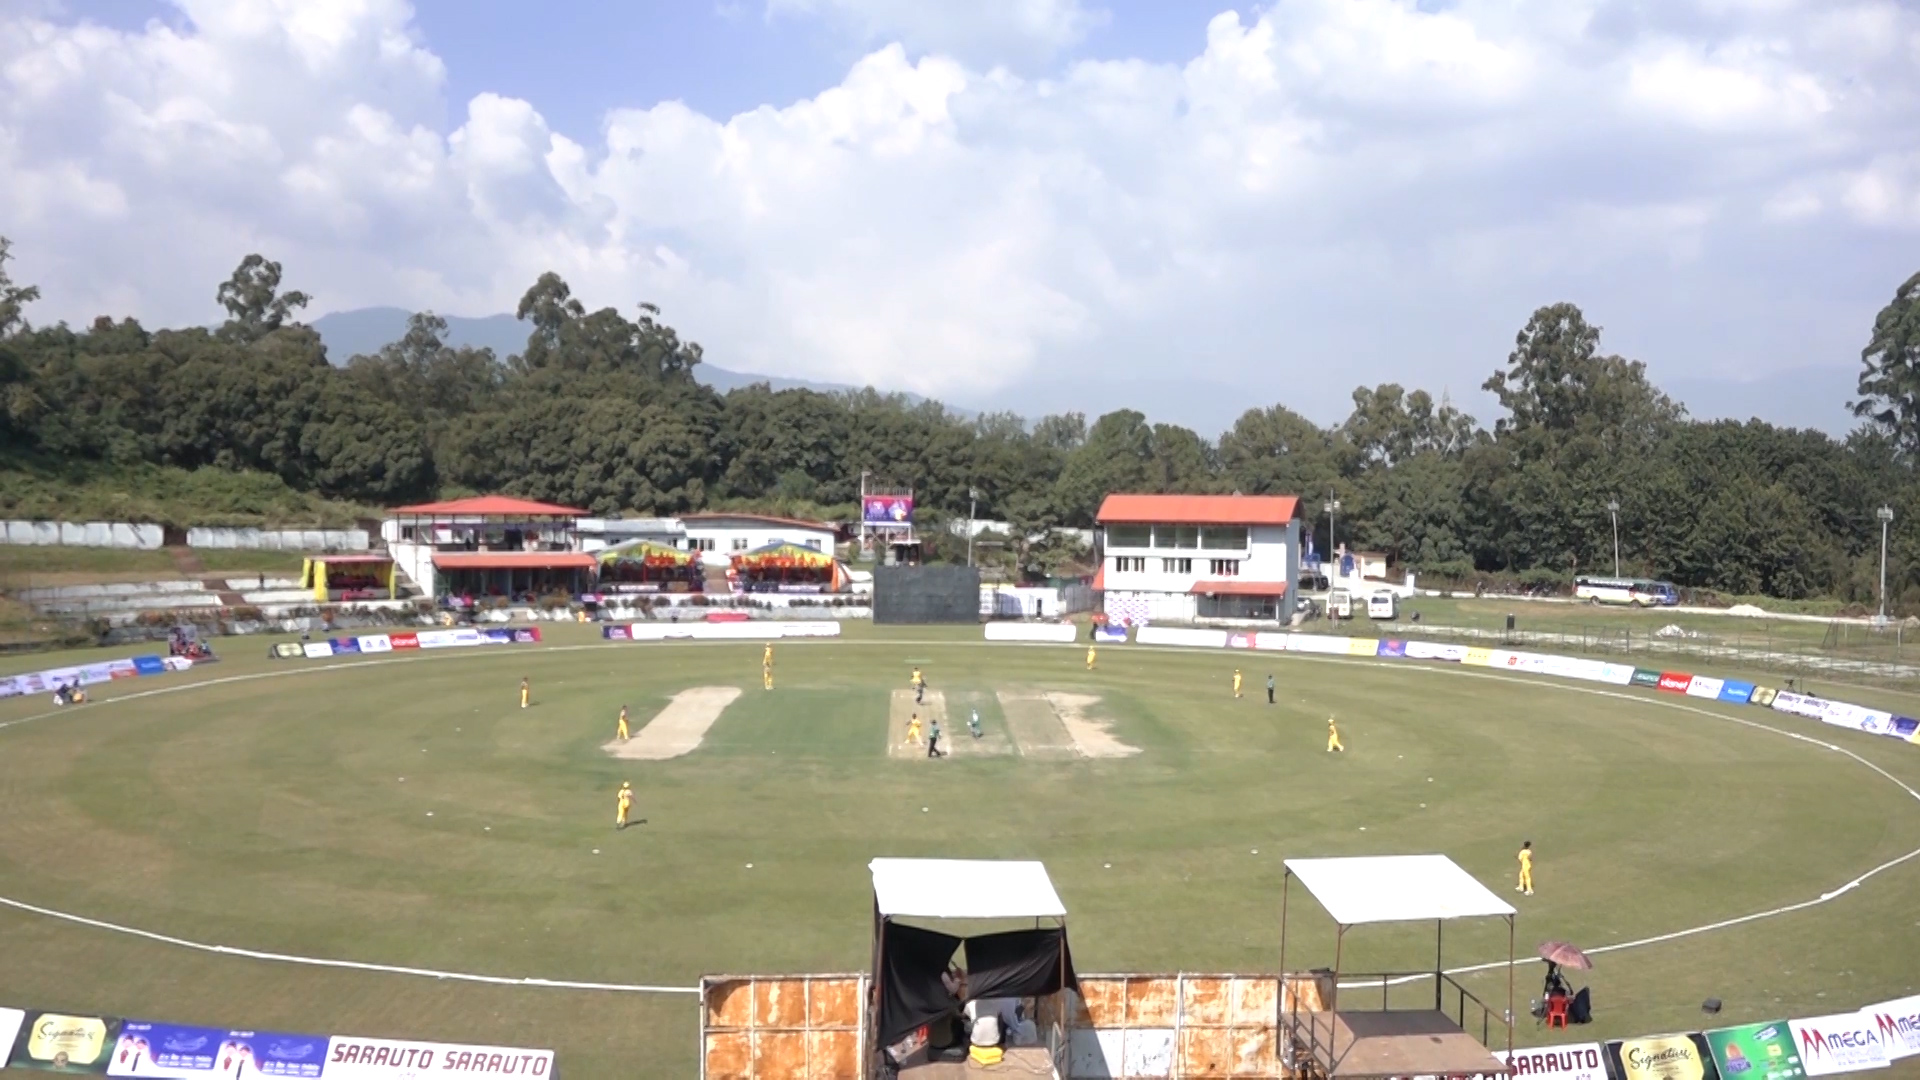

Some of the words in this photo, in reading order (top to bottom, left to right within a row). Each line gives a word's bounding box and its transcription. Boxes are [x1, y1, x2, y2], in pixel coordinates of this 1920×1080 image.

[331, 1043, 434, 1069] SARAUTO
[442, 1051, 548, 1076] SARAUTO
[1628, 1047, 1692, 1070] Signature
